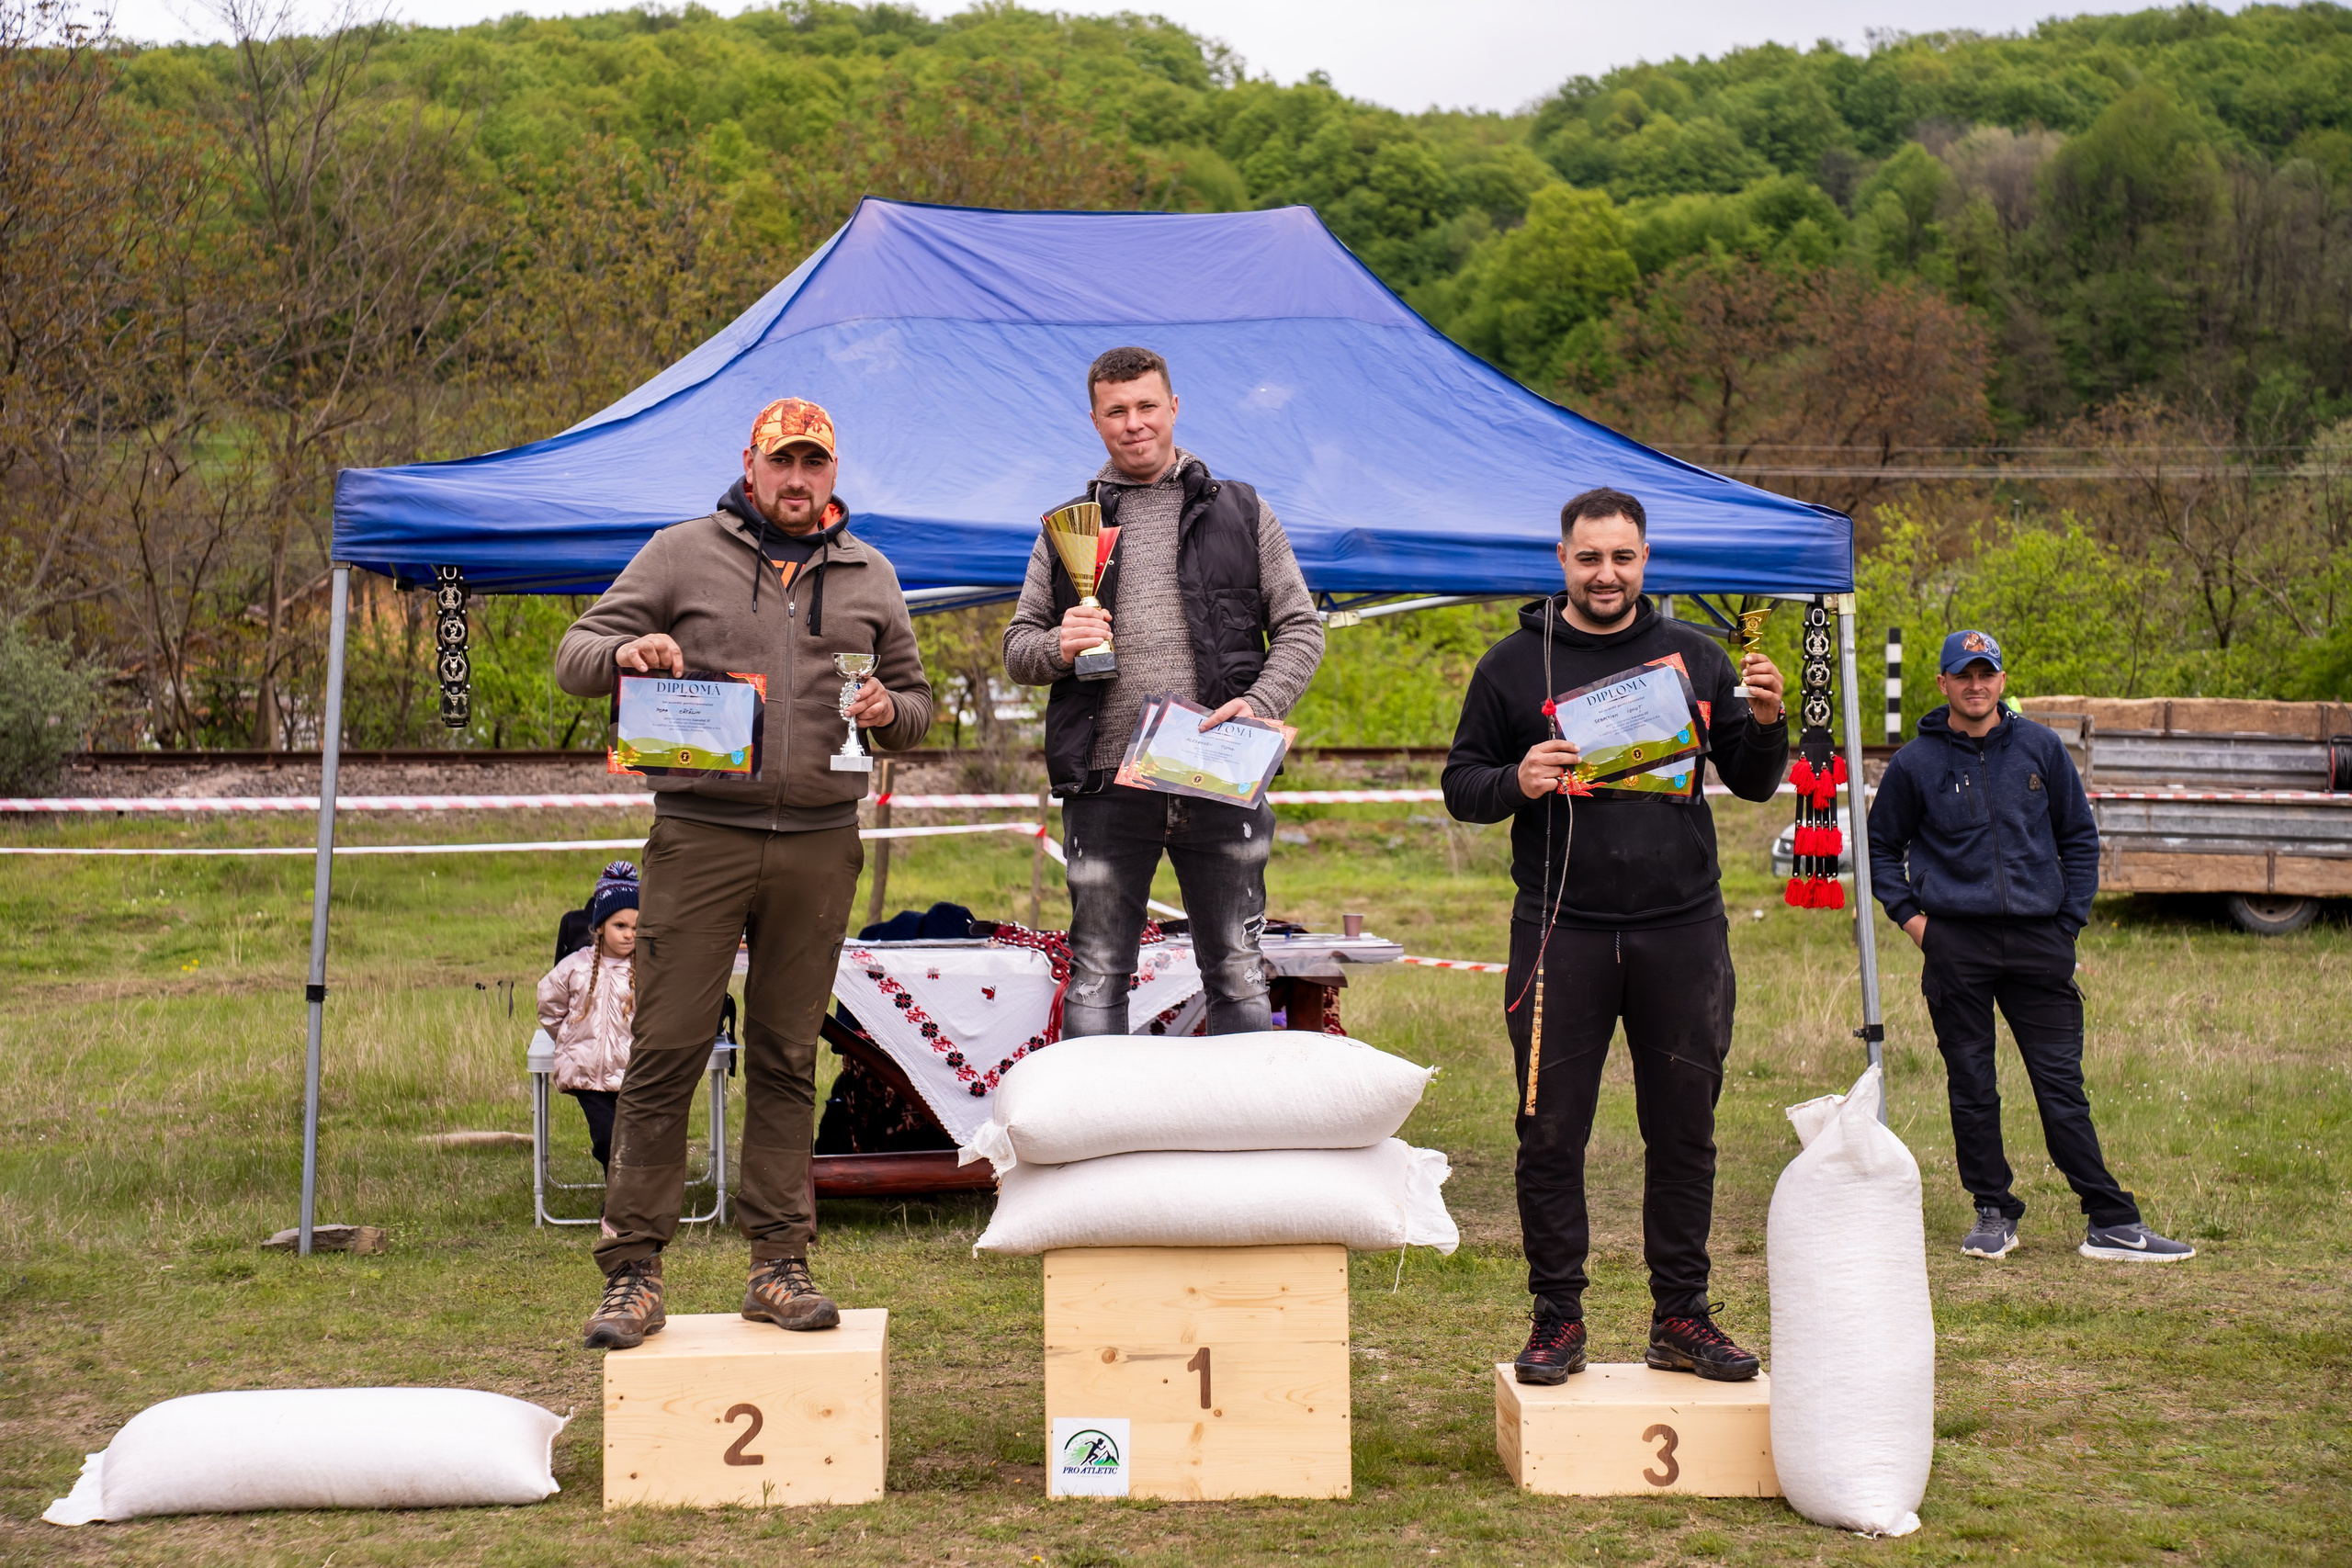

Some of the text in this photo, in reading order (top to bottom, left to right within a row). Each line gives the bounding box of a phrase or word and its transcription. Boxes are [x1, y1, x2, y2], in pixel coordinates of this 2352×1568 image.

[657, 682, 720, 695] DIPLOMĂ
[1587, 677, 1646, 705] DIPLOMĂ
[1187, 1347, 1212, 1409] 1
[723, 1403, 764, 1466] 2
[1642, 1424, 1679, 1486] 3
[1062, 1466, 1118, 1474] PRO ATLETIC
